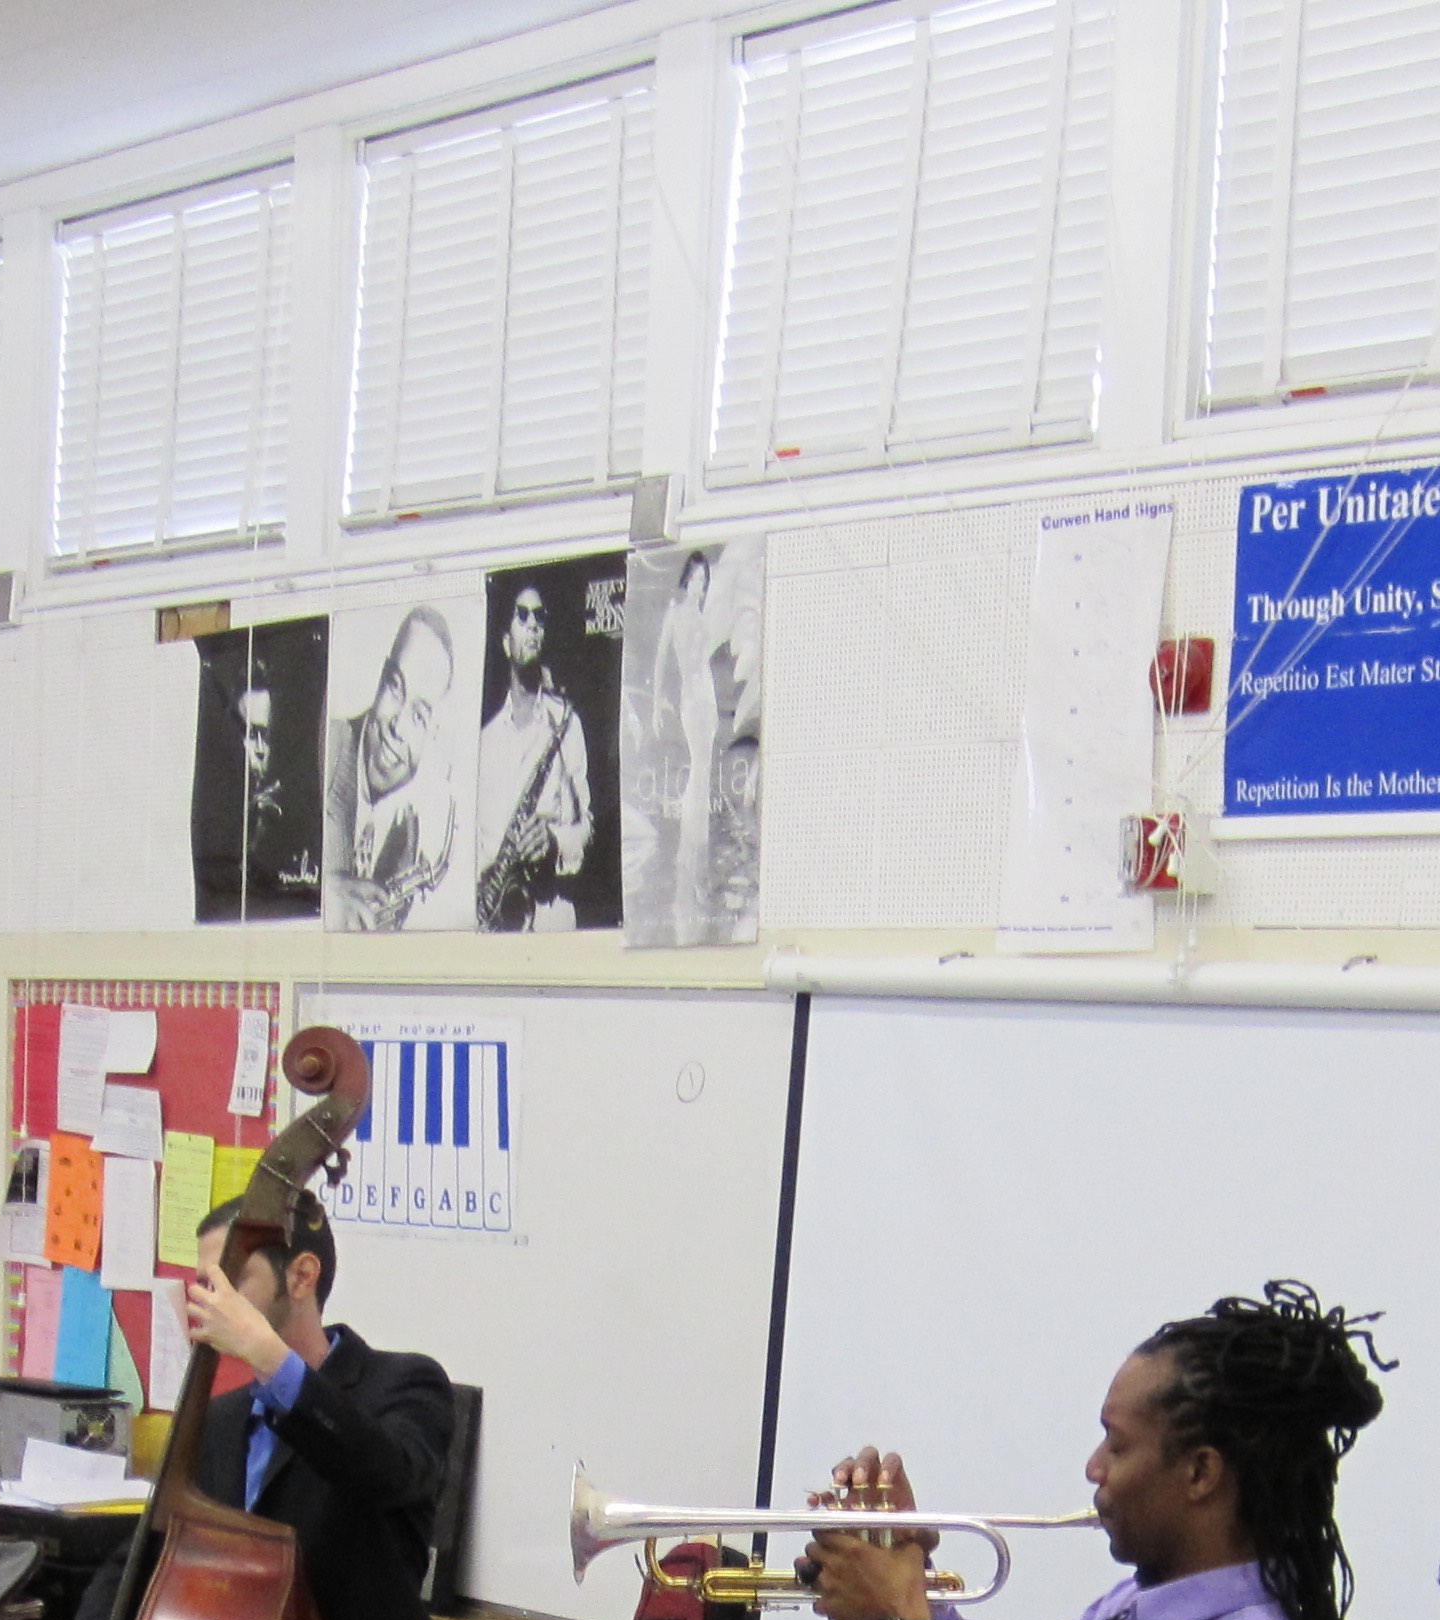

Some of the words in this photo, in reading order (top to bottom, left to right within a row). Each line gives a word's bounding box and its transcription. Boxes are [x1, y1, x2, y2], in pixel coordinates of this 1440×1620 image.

[1095, 504, 1130, 524] Hand
[1250, 493, 1306, 534] Per
[1247, 586, 1346, 626] Through
[1354, 581, 1424, 618] Unity,
[1240, 666, 1320, 701] Repetitio
[1325, 663, 1355, 690] Est
[1360, 659, 1416, 687] Mater
[1235, 774, 1320, 807] Repetition
[1325, 774, 1341, 798] Is
[1345, 773, 1373, 797] the
[319, 1183, 330, 1202] C
[342, 1184, 354, 1204] D
[366, 1185, 378, 1206] E
[390, 1186, 401, 1208] F
[414, 1187, 425, 1209] G
[439, 1188, 452, 1212] A
[465, 1191, 477, 1213] B
[489, 1192, 502, 1213] C
